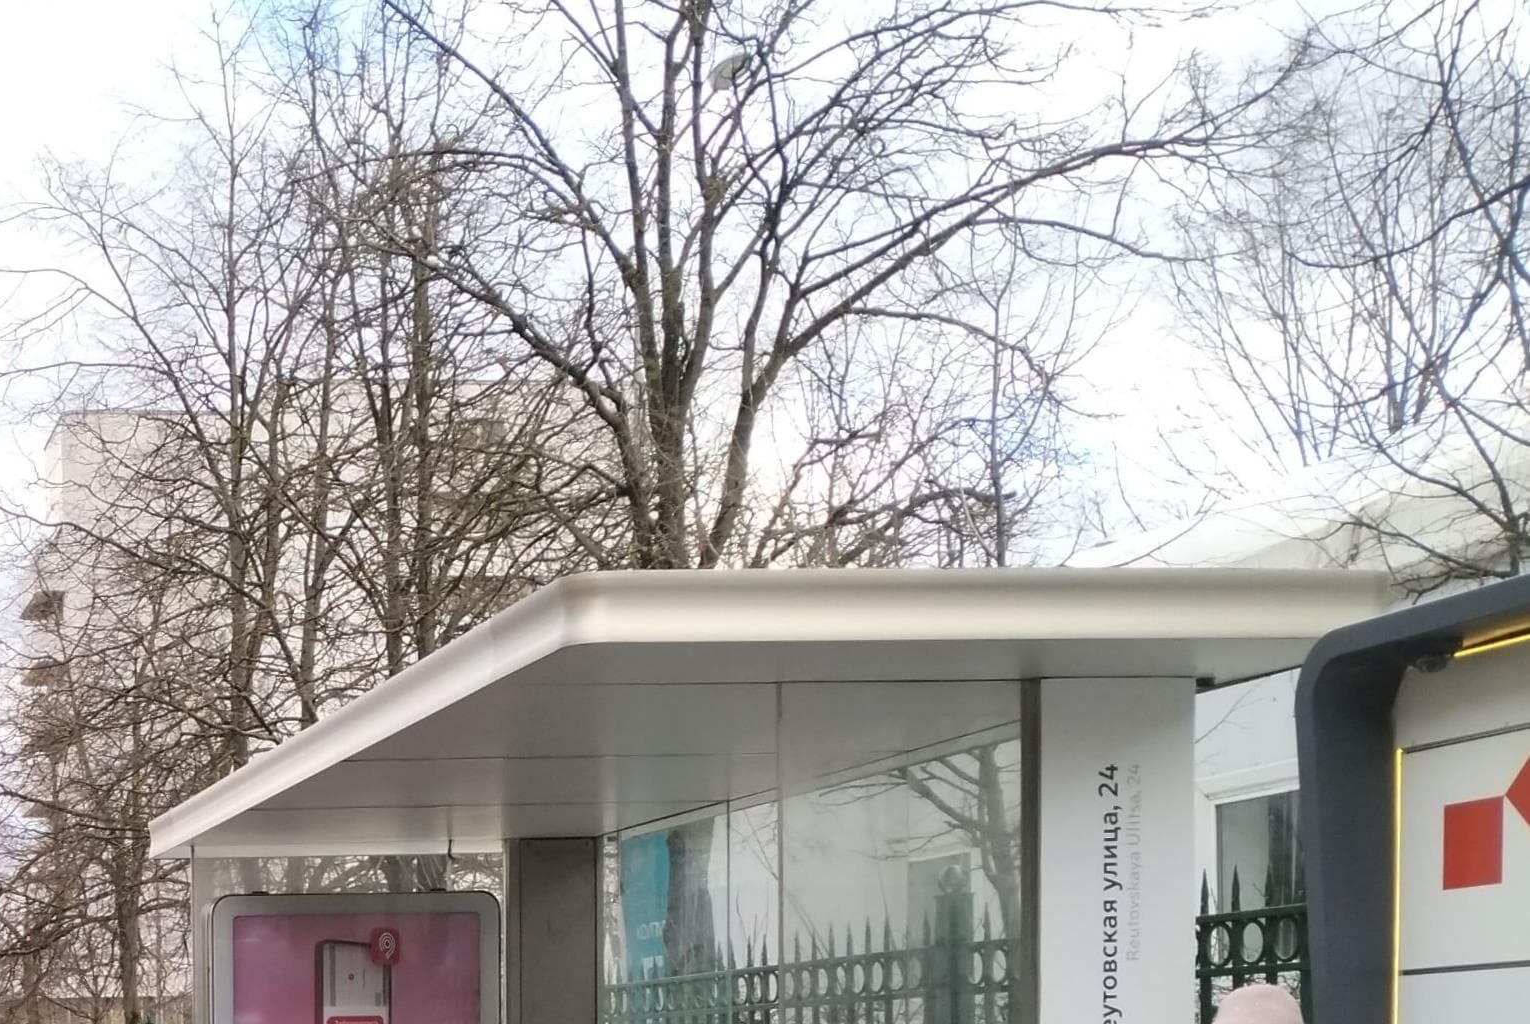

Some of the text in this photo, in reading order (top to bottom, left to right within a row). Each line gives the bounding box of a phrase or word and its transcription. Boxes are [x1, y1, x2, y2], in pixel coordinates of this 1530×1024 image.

[1098, 763, 1119, 798] 24
[1126, 763, 1140, 785] 24
[1103, 804, 1123, 892] улица,
[1126, 852, 1143, 961] Reutovskaya
